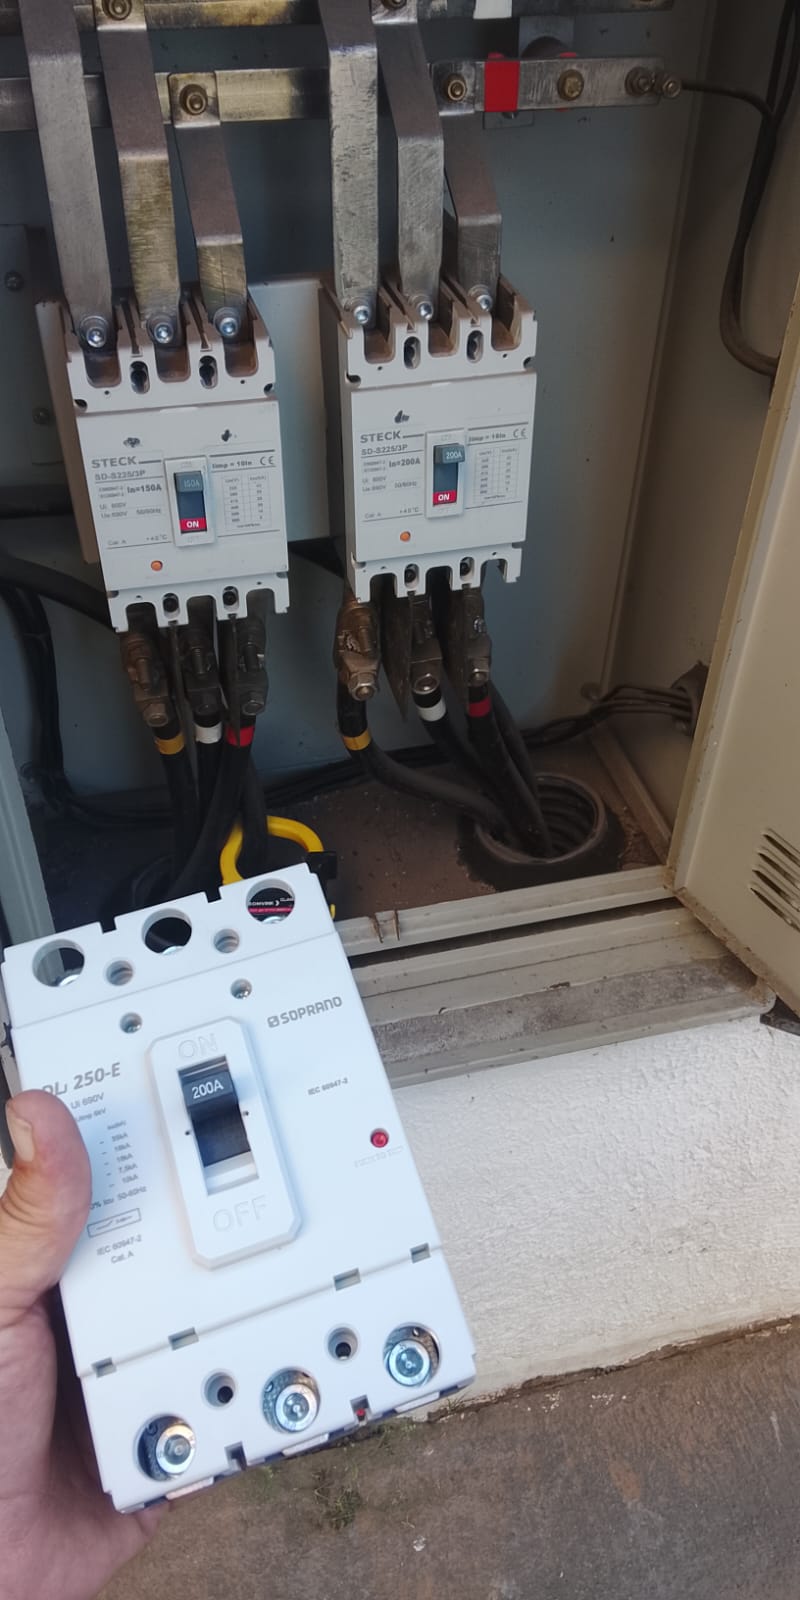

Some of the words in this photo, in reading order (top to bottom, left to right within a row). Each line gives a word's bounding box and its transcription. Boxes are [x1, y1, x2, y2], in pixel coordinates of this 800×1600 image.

[360, 430, 401, 444] STECK
[361, 444, 408, 456] SD-S225/3P
[446, 451, 463, 460] 200A
[91, 455, 137, 469] STECK
[95, 469, 146, 480] SD-S225/3P
[127, 483, 162, 494] In=150A
[184, 479, 201, 488] 150A
[438, 493, 450, 501] ON
[186, 520, 200, 529] ON
[280, 996, 343, 1025] SOPRANO
[178, 1033, 218, 1059] ON
[73, 1062, 121, 1090] 250-E
[192, 1079, 225, 1100] 200A
[307, 1086, 321, 1096] IEC
[213, 1194, 268, 1232] OFF
[96, 1245, 111, 1256] IEC
[128, 1250, 135, 1259] A
